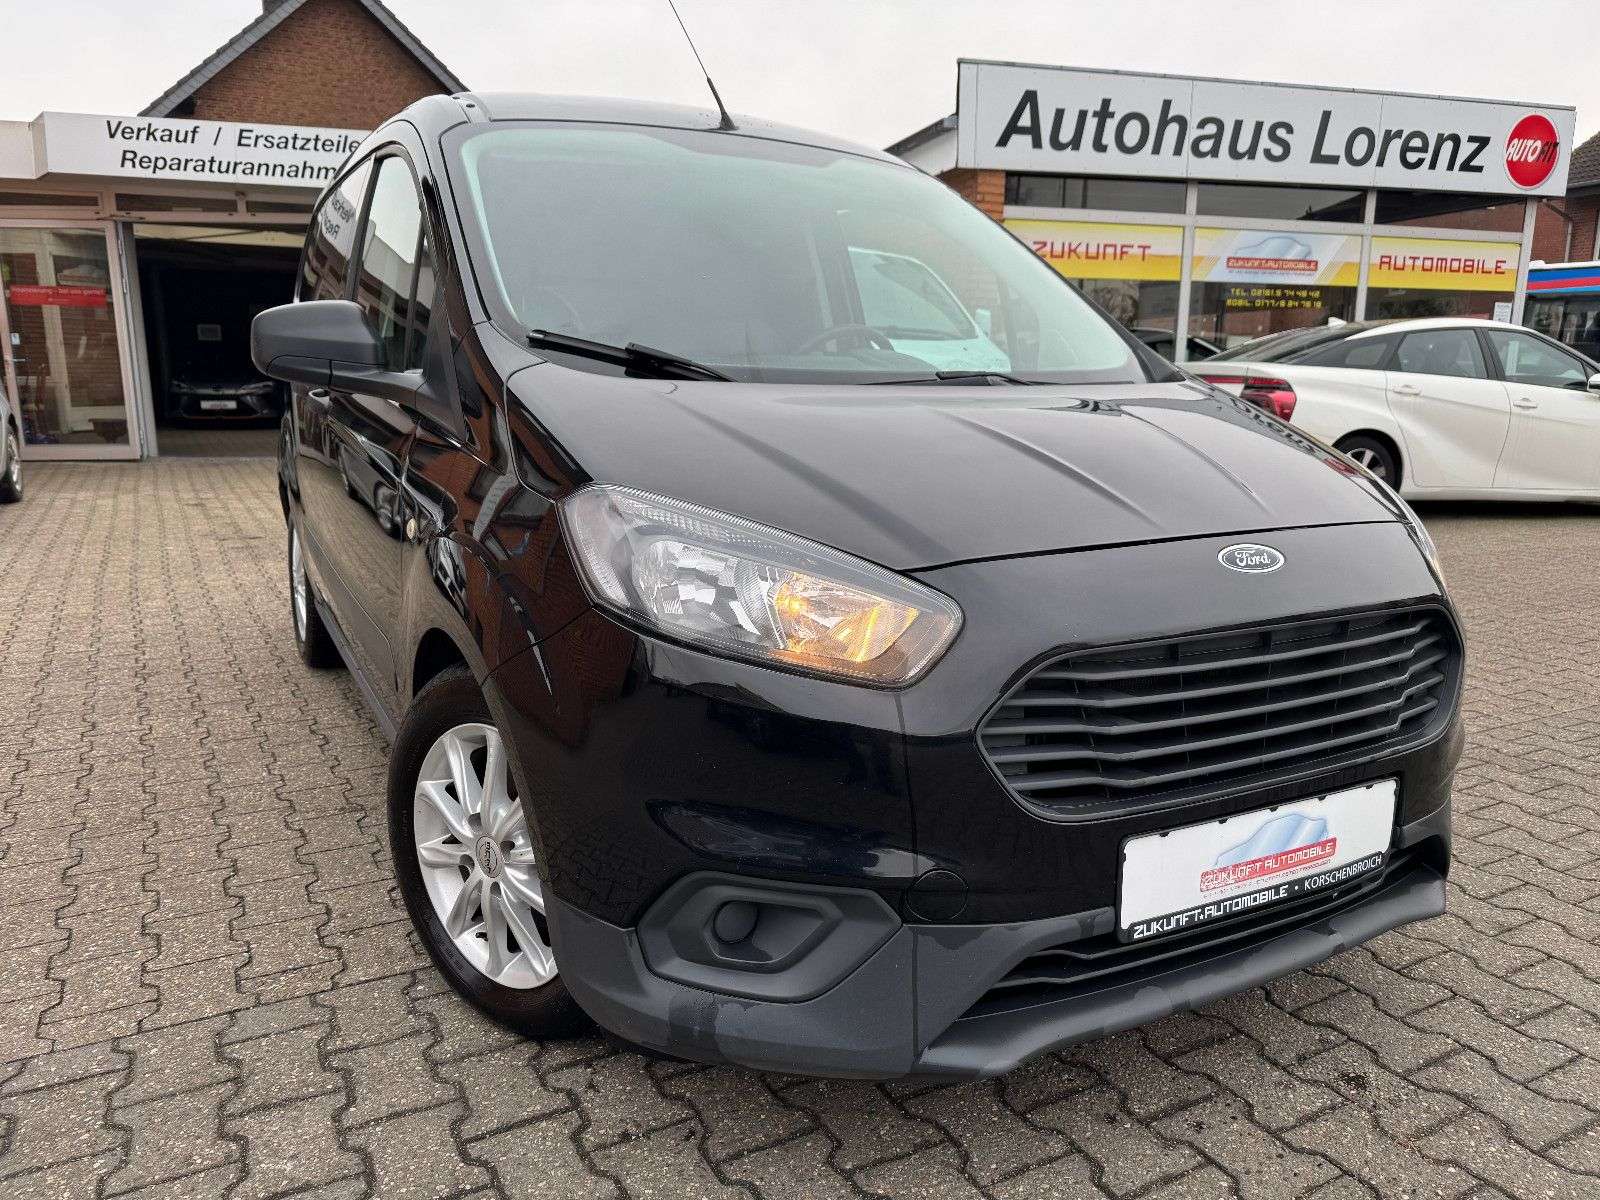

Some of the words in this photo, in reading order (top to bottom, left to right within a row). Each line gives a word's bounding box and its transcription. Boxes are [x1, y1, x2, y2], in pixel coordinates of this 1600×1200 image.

[106, 120, 199, 145] Verkauf
[213, 127, 222, 146] /
[236, 128, 360, 154] Ersatzteile
[995, 89, 1294, 163] Autohaus
[1309, 110, 1491, 174] Lorenz
[1032, 241, 1152, 261] ZUKUNFT
[1379, 255, 1507, 275] AUTOMOBILE
[1234, 549, 1271, 567] Ford
[1304, 854, 1382, 891] KORSCHENBROICH
